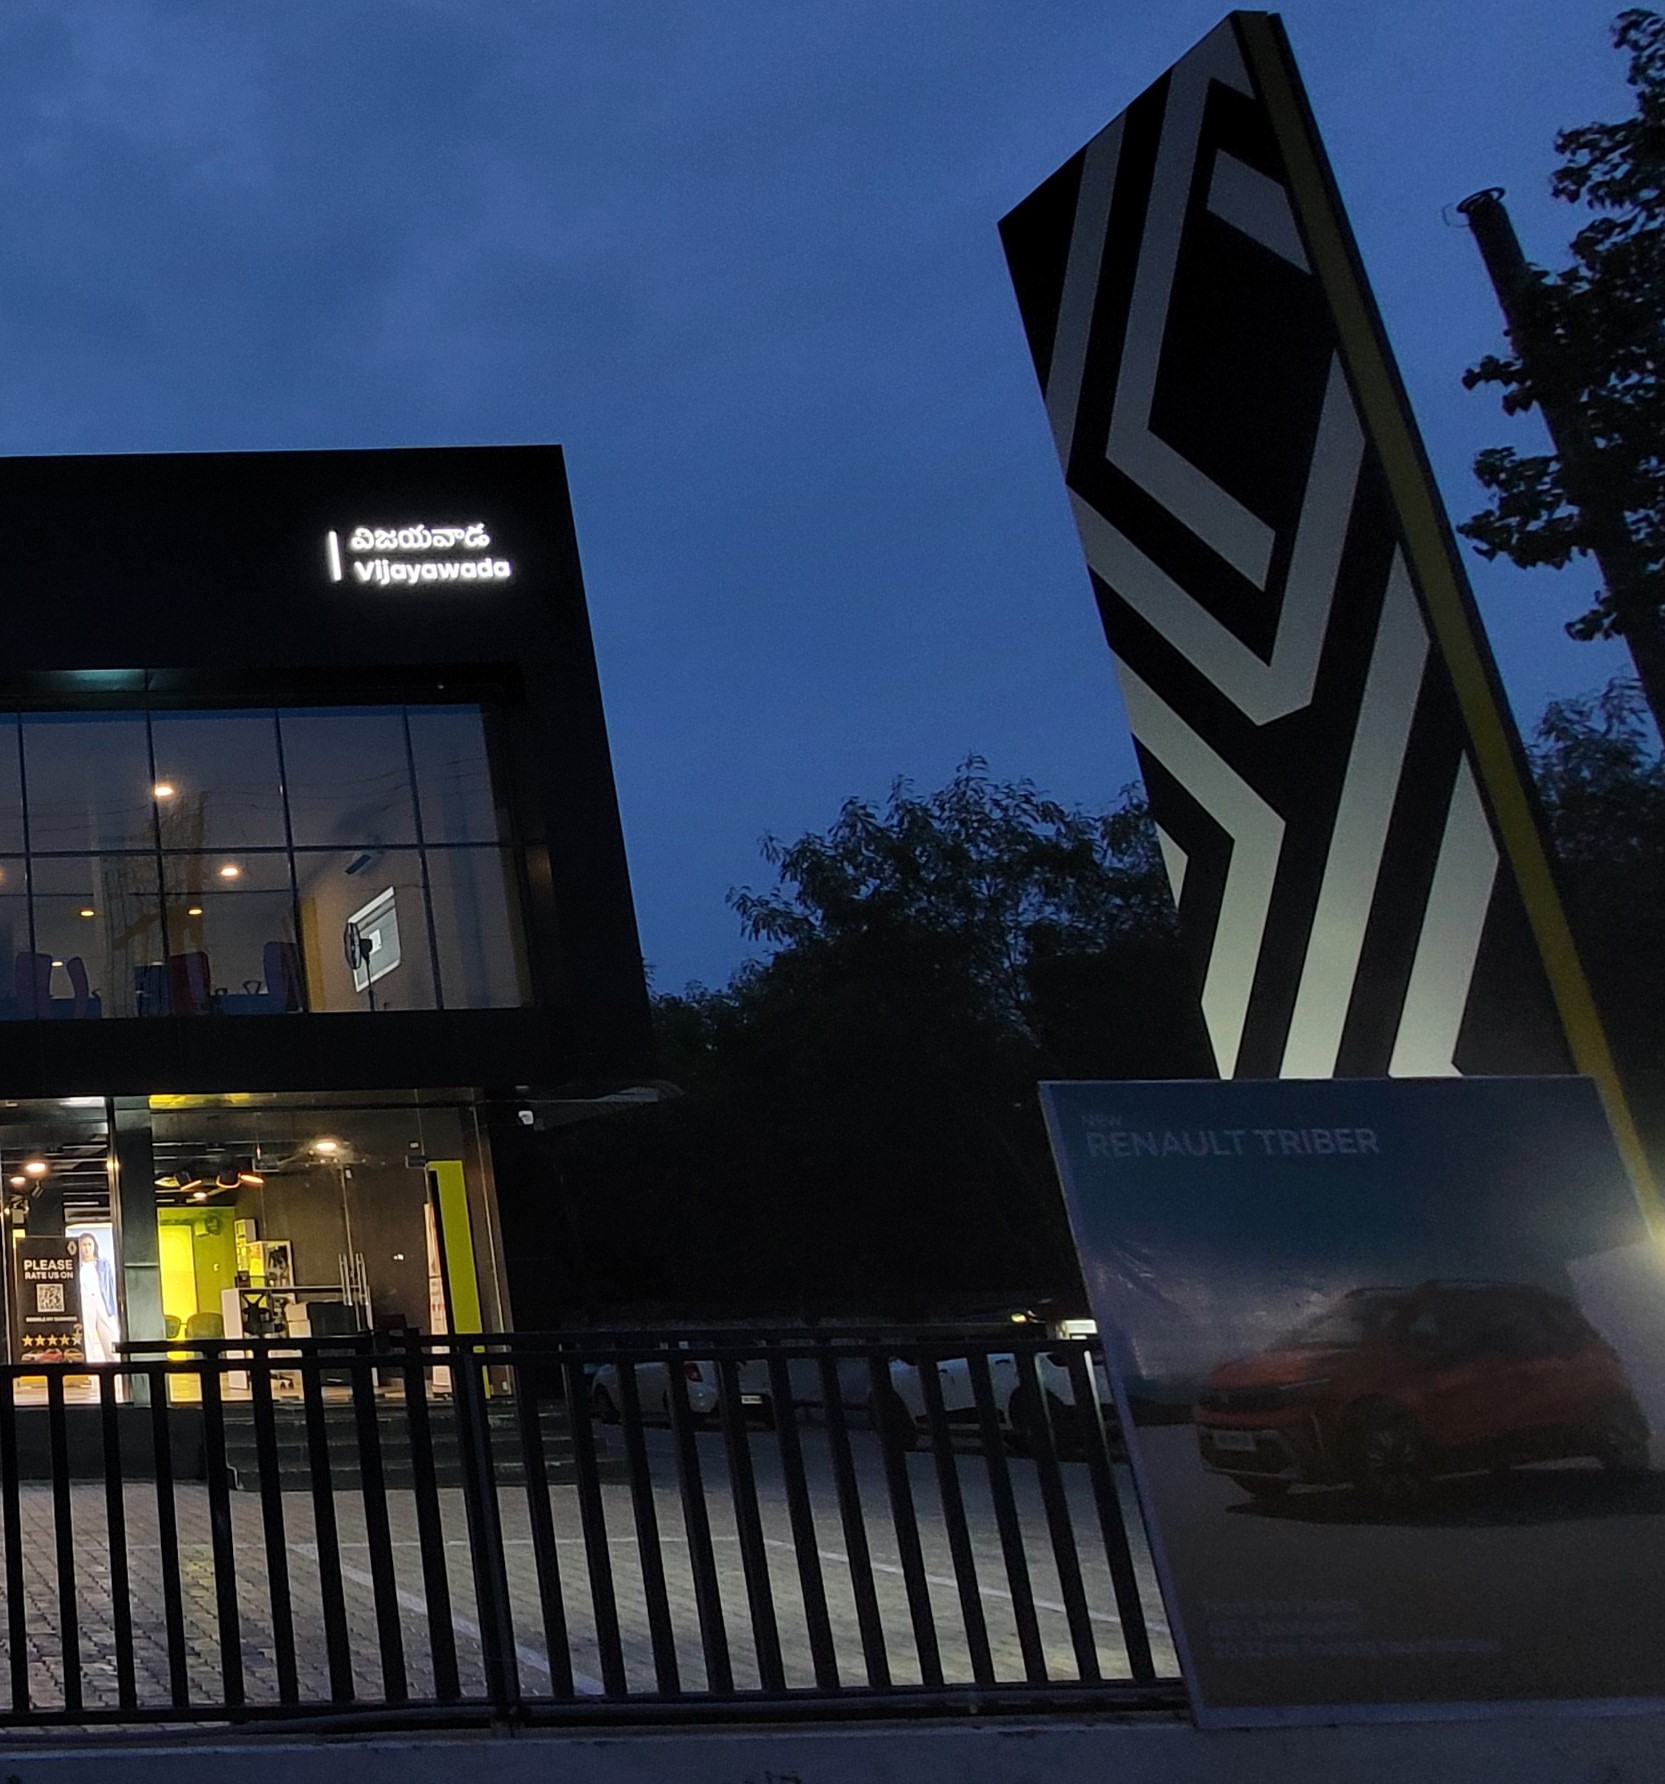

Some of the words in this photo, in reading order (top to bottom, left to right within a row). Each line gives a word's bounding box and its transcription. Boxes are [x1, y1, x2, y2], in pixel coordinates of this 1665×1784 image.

[350, 523, 491, 550] విజయవాడ
[354, 557, 511, 585] Vijayawada
[1086, 1129, 1247, 1158] RENAULT
[1251, 1127, 1381, 1155] TRIBER
[23, 1259, 74, 1271] PLEASE
[24, 1271, 47, 1280] RATE
[47, 1271, 59, 1280] US
[60, 1271, 74, 1279] ON
